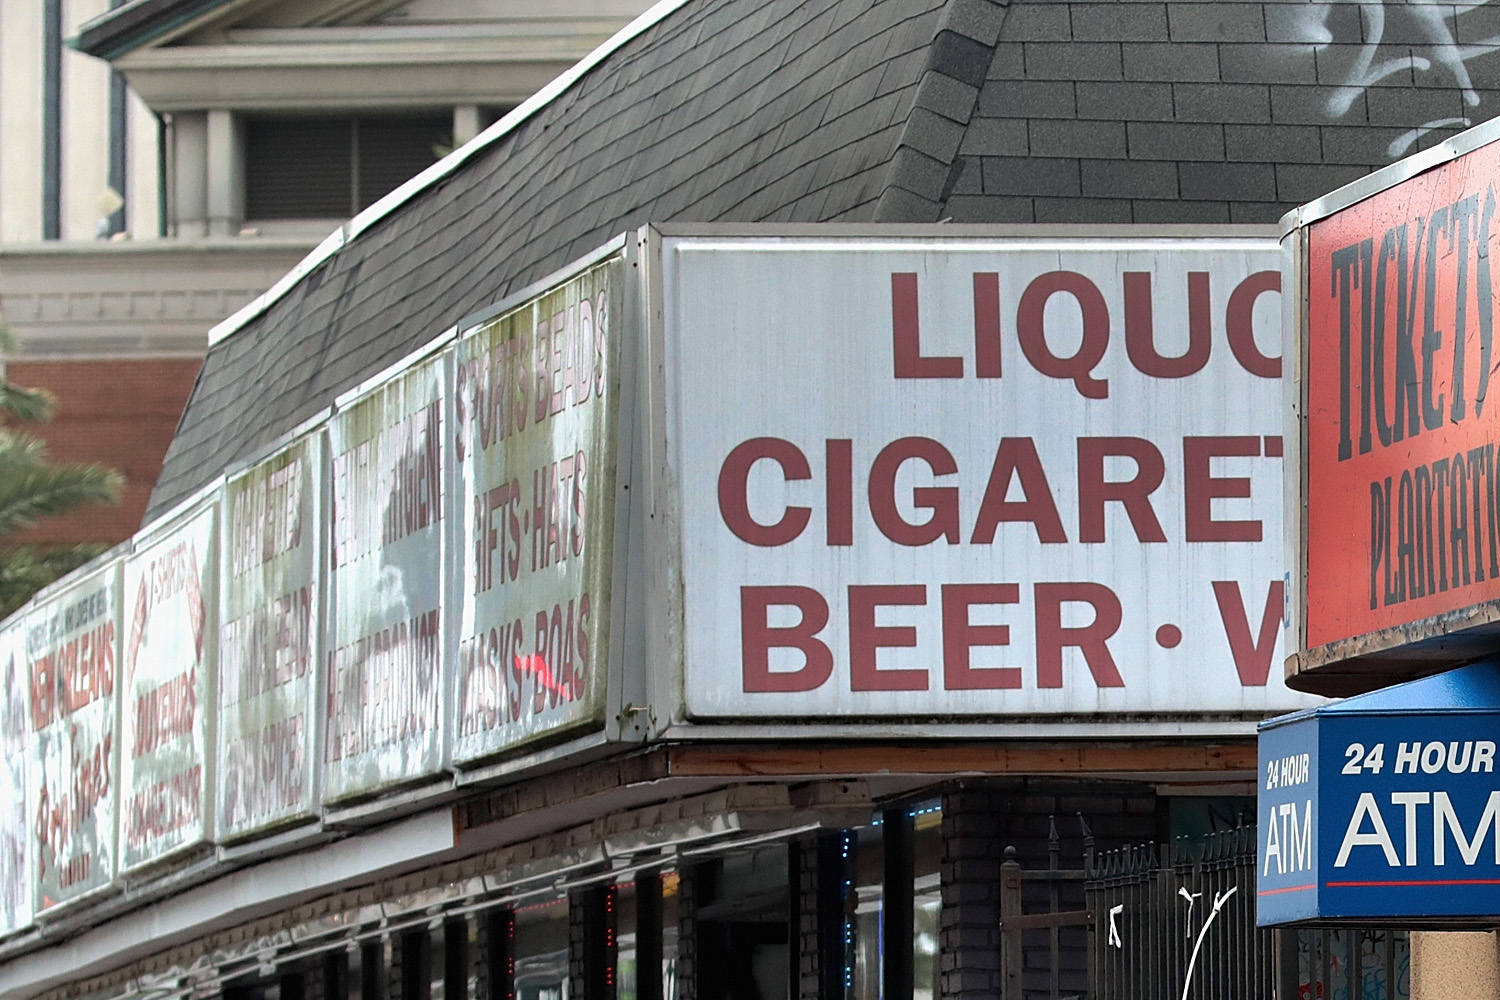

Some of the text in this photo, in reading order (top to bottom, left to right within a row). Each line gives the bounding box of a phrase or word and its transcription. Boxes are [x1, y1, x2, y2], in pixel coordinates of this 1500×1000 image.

[534, 289, 607, 425] BEADS
[1331, 183, 1497, 463] TICKETS
[473, 449, 587, 597] GIFTS HATS
[717, 436, 1283, 547] CIGARE
[458, 592, 591, 740] MASKS BOAS
[739, 581, 1125, 694] BEER
[1266, 753, 1310, 790] 24 HOUR
[1341, 740, 1496, 774] 24 HOUR
[1263, 799, 1312, 877] ATM
